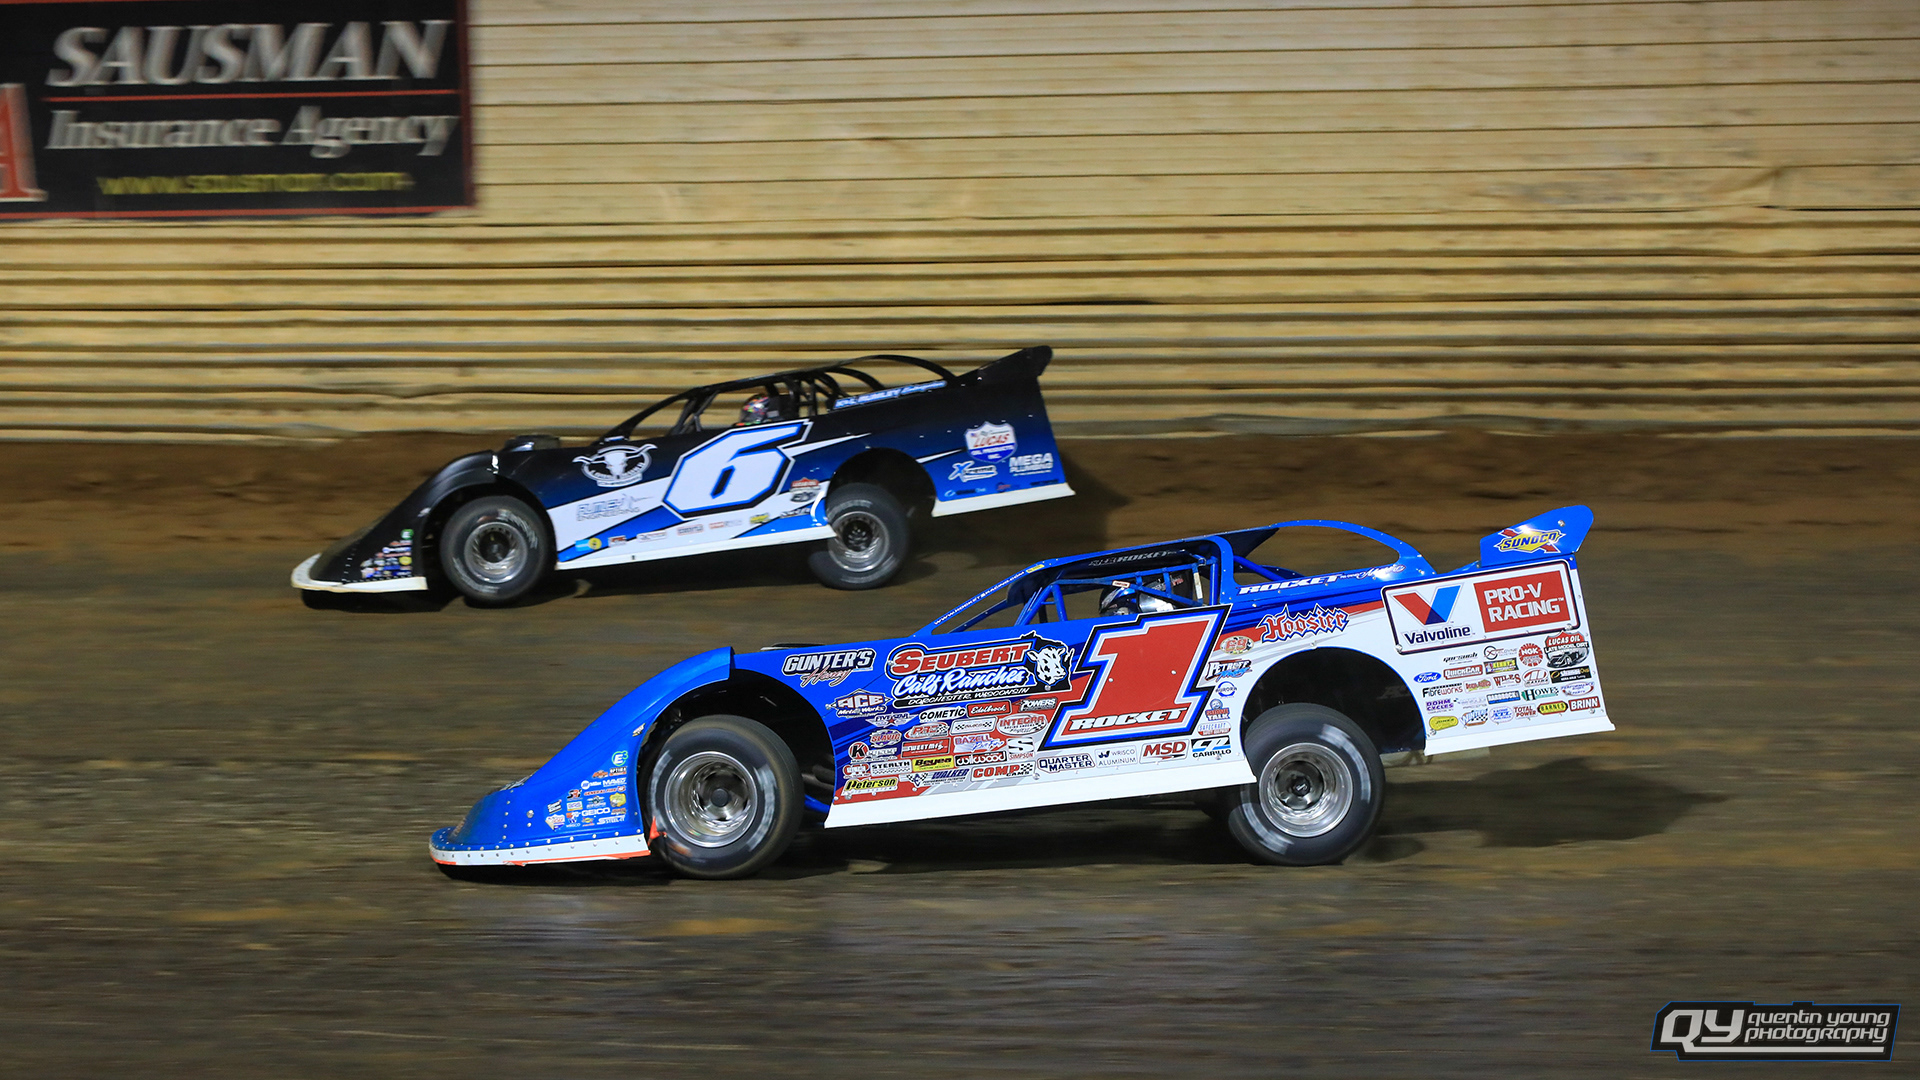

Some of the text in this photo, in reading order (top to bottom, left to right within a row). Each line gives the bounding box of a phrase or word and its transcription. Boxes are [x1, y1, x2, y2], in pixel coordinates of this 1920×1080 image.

[45, 19, 455, 86] SAUSMAN
[45, 105, 460, 159] Insurance Agency
[973, 433, 1010, 448] LUCAS
[1009, 453, 1053, 467] MEGA
[663, 422, 802, 516] 6
[1503, 532, 1560, 549] SUNOCO
[1238, 574, 1342, 595] ROCKET
[1484, 582, 1542, 605] PRO-V
[1265, 609, 1348, 640] Hoosier
[1404, 626, 1471, 644] Valvoline
[1548, 636, 1569, 646] LUCAS
[1521, 647, 1539, 655] NGK
[783, 649, 875, 673] GUNTER'S
[892, 644, 1030, 673] SEUBERT
[1207, 660, 1250, 677] PETROFF
[894, 666, 1027, 698] Calf Ranches
[1054, 615, 1216, 741] 1
[1418, 672, 1438, 682] Ford
[1527, 686, 1556, 701] HOWE
[837, 695, 884, 709] ACE
[1021, 699, 1056, 711] POWERS
[1541, 703, 1565, 711] BARNES
[1571, 698, 1598, 708] BRINN
[920, 708, 966, 720] COMETIC
[971, 705, 1007, 714] Edelbrock
[1514, 705, 1533, 713] TOTAL
[1000, 716, 1044, 727] INTEGRA
[1069, 707, 1189, 731] ROCKET
[955, 735, 992, 745] BAZELL
[1143, 742, 1187, 757] MSD
[871, 761, 910, 769] STEALTH
[1039, 755, 1090, 768] QUARTER
[1050, 761, 1093, 772] MASTER
[1098, 757, 1136, 766] ALUMINUM
[932, 769, 969, 779] WALKER
[973, 765, 1020, 778] COMP
[845, 779, 895, 790] Peterson
[581, 807, 610, 816] GEICO
